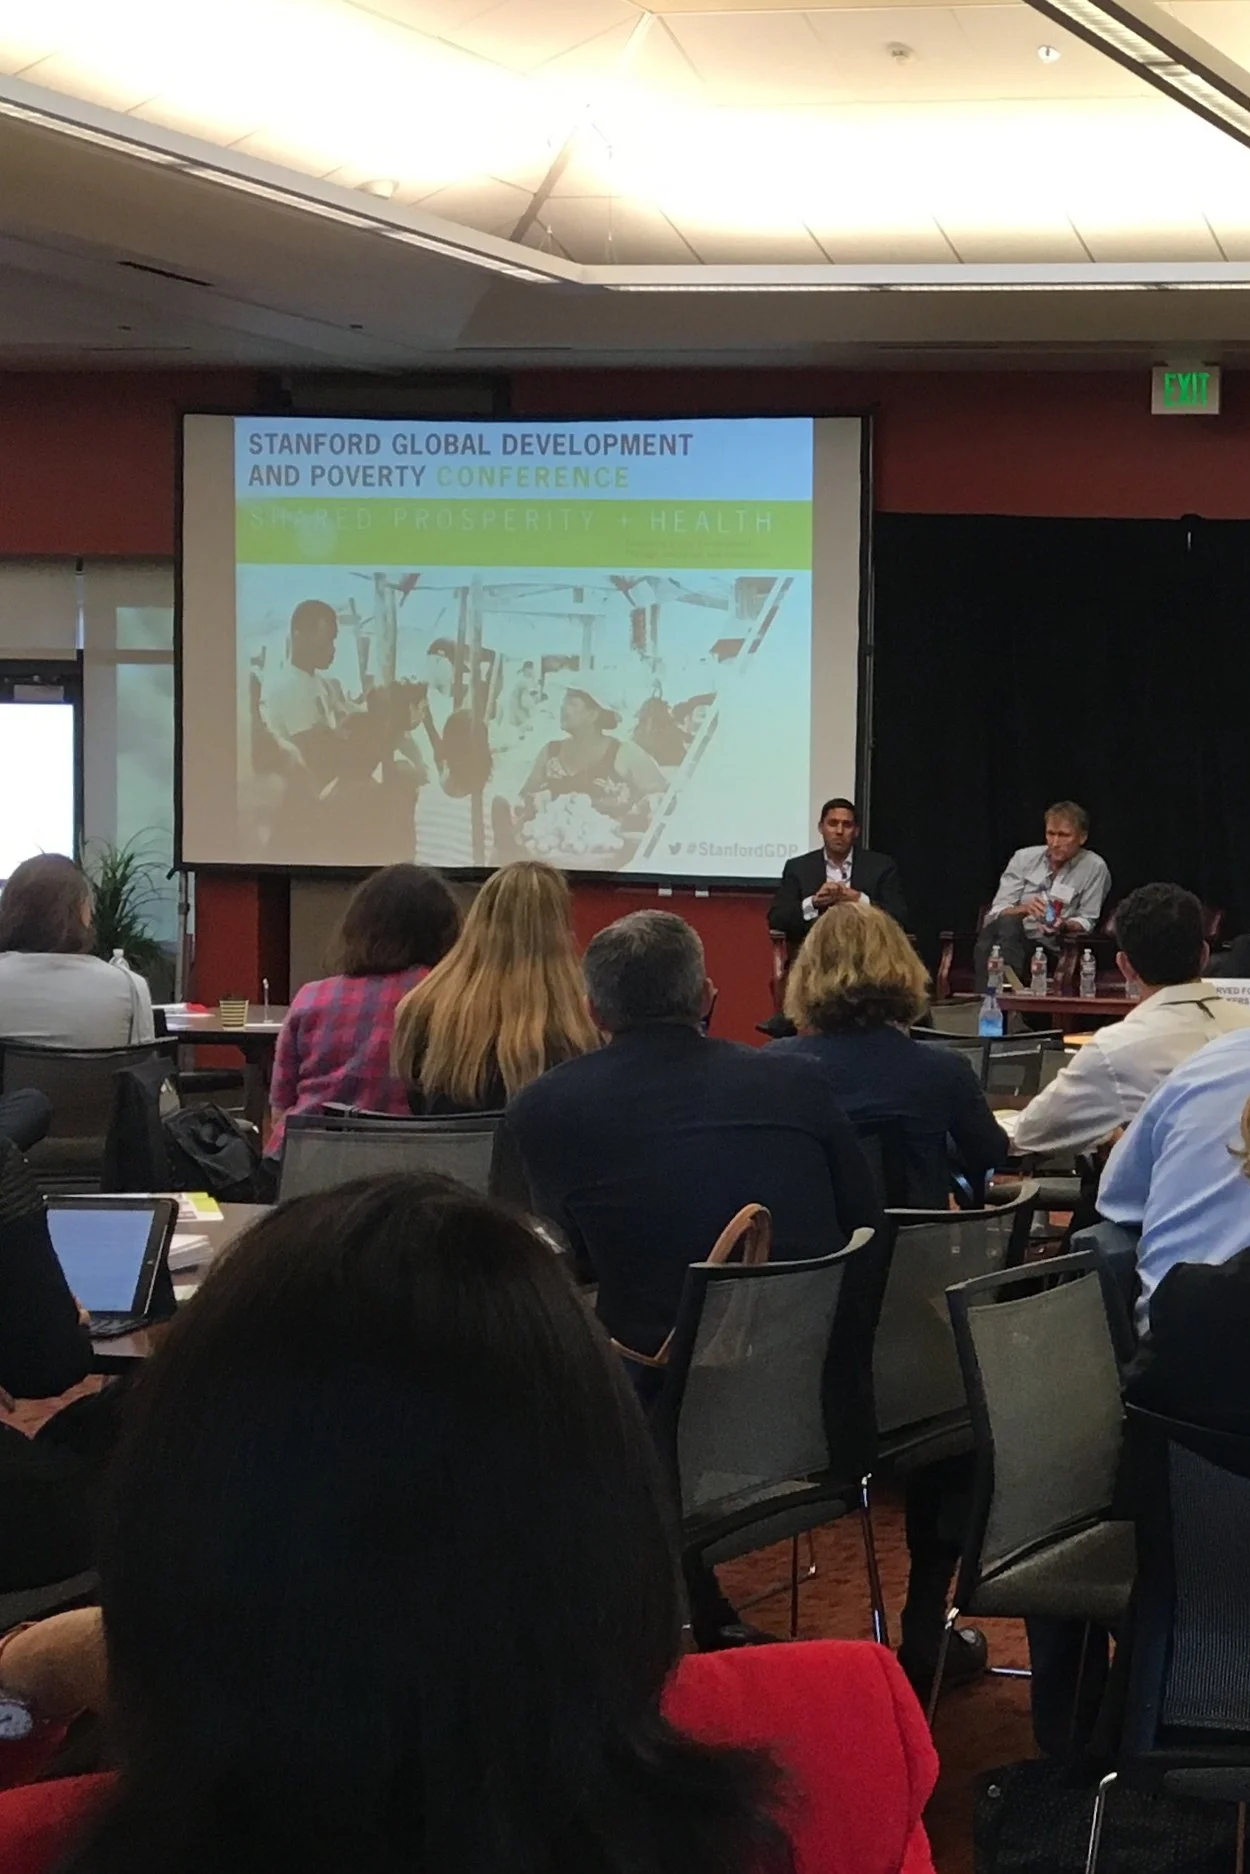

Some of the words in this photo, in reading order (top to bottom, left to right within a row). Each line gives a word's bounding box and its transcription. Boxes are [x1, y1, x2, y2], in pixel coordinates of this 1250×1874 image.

[1164, 372, 1209, 408] EXIT
[249, 432, 381, 456] STANFORD
[392, 432, 491, 456] GLOBAL
[502, 432, 694, 456] DEVELOPMENT
[248, 464, 300, 487] AND
[310, 464, 426, 488] POVERTY
[436, 465, 629, 489] CONFERENCE
[393, 507, 595, 532] PROSPERITY
[650, 509, 773, 533] HEALTH
[685, 841, 799, 859] #StanfordGDP
